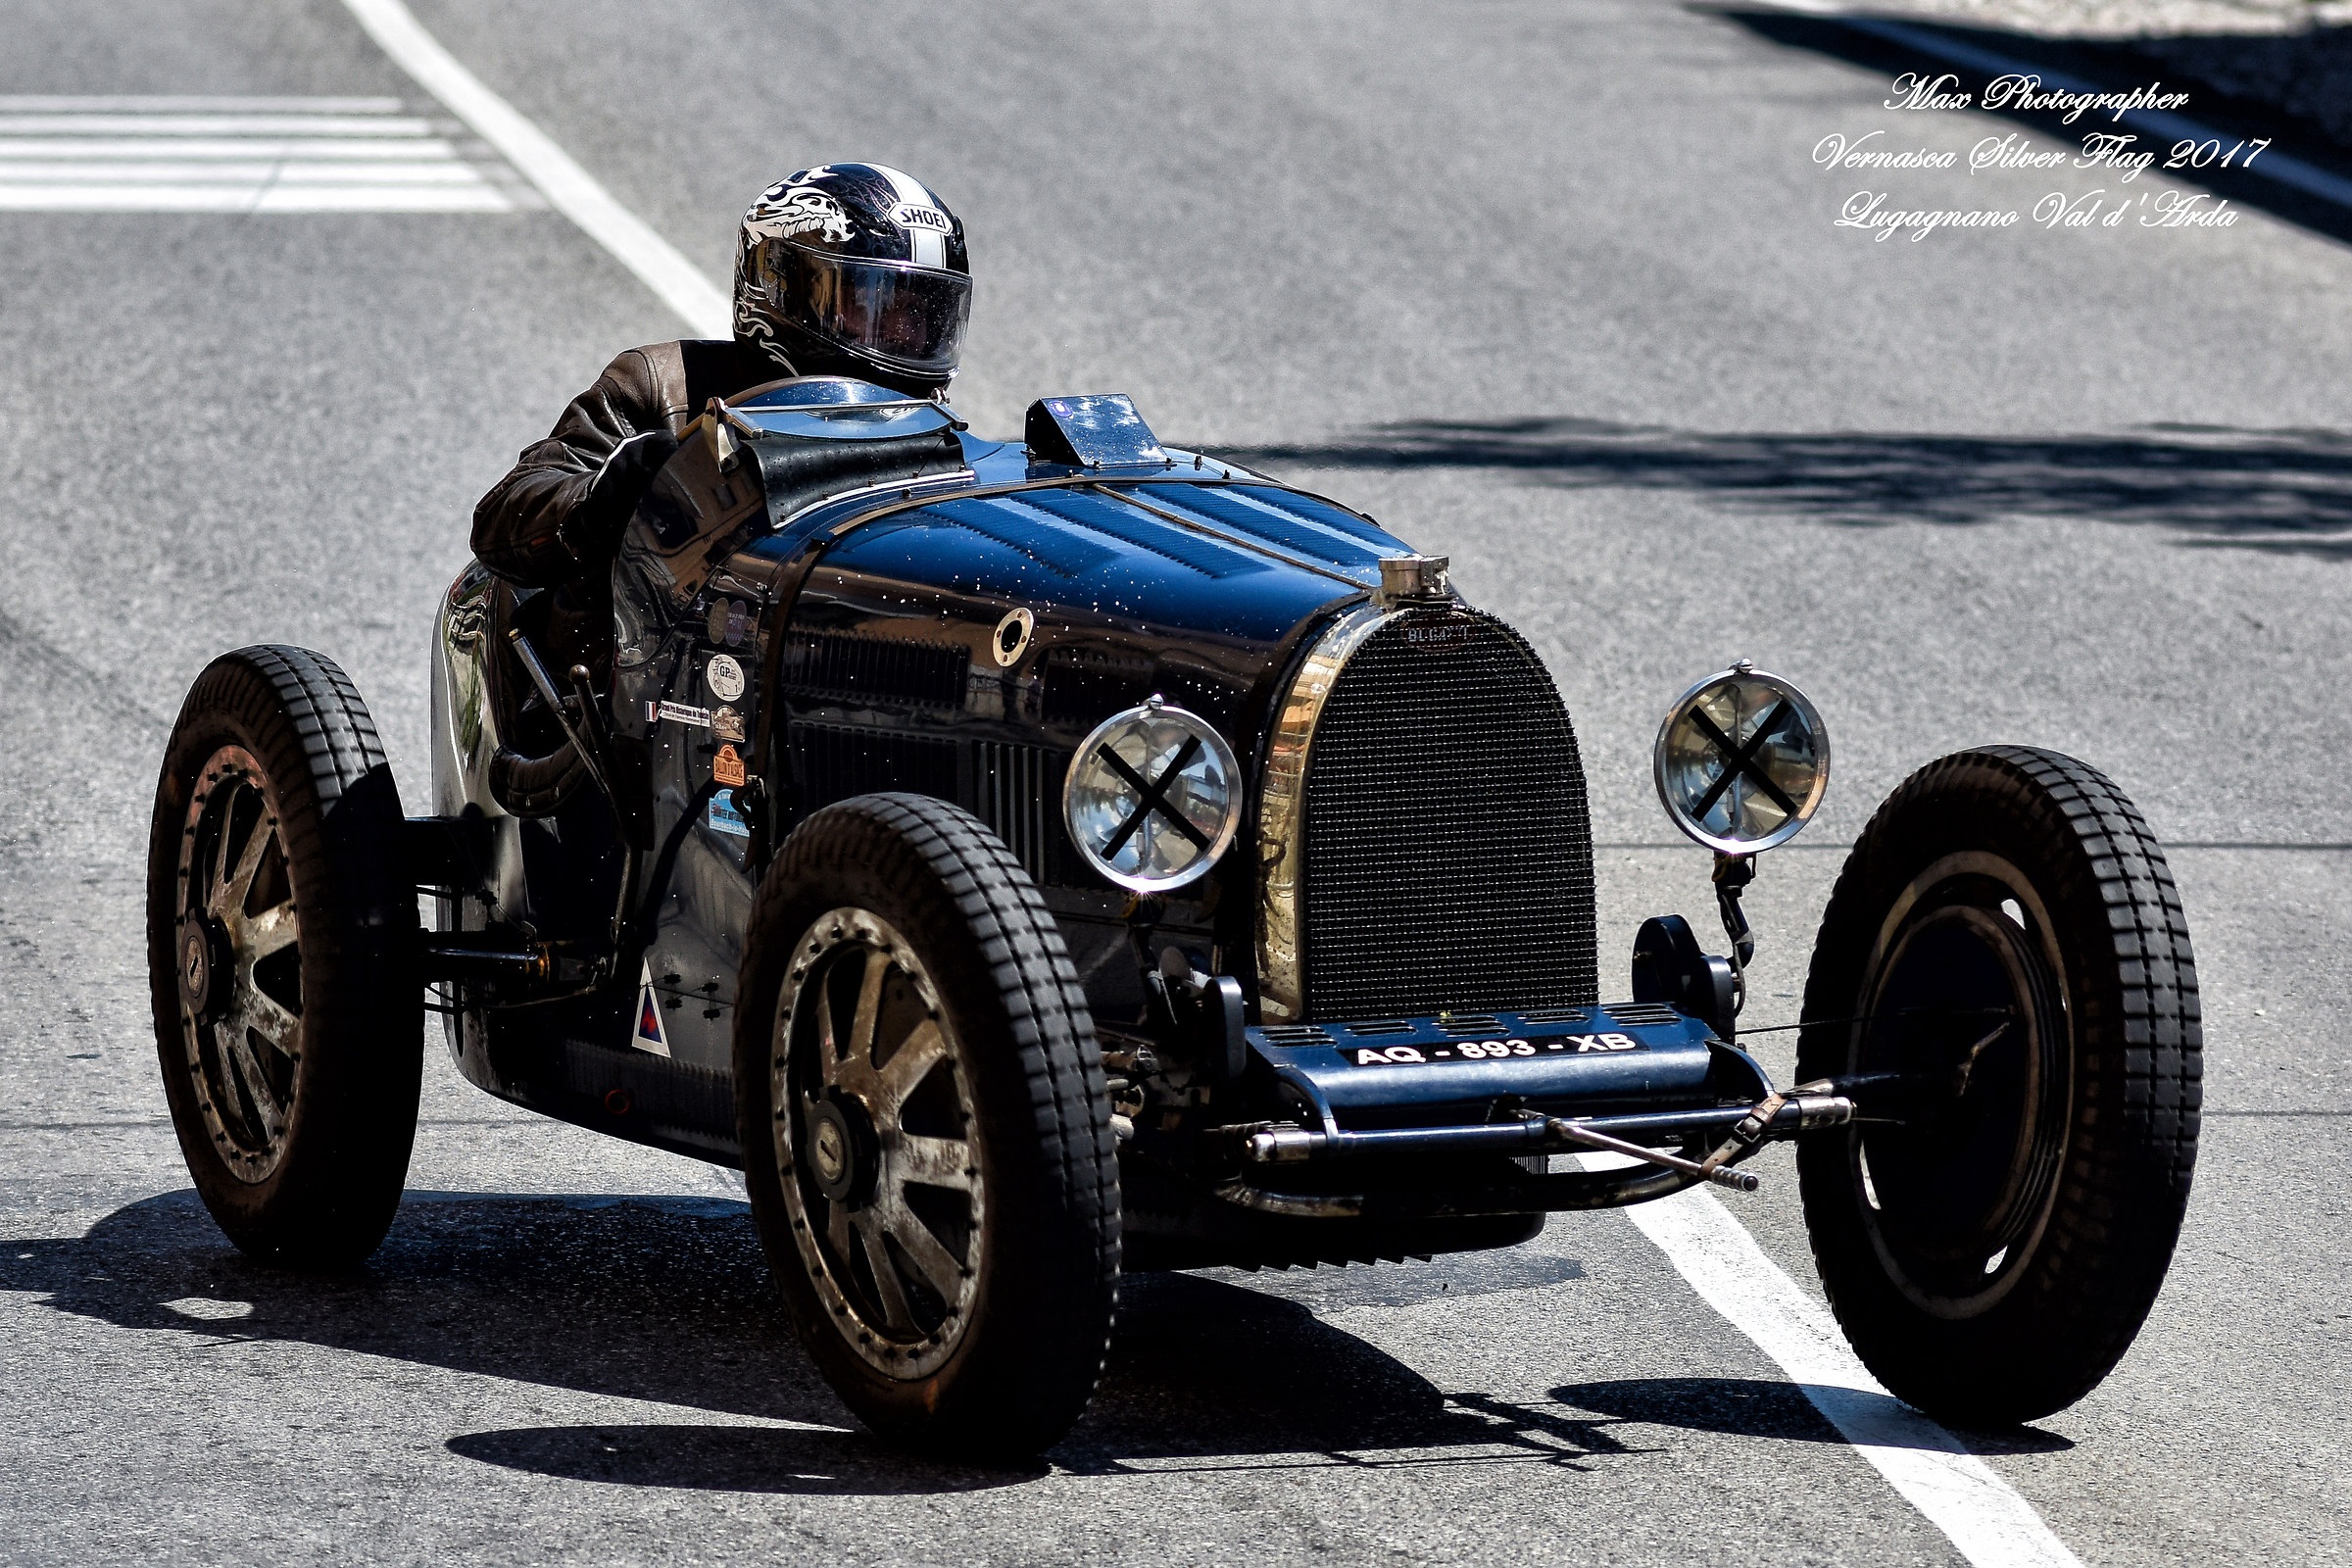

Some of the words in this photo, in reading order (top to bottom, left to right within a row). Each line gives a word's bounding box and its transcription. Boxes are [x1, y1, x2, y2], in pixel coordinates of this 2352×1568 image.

[900, 208, 947, 229] SHOEI
[719, 665, 730, 678] GP
[1357, 1046, 1427, 1065] AQ
[1456, 1039, 1537, 1059] 893
[1566, 1032, 1638, 1053] XB
